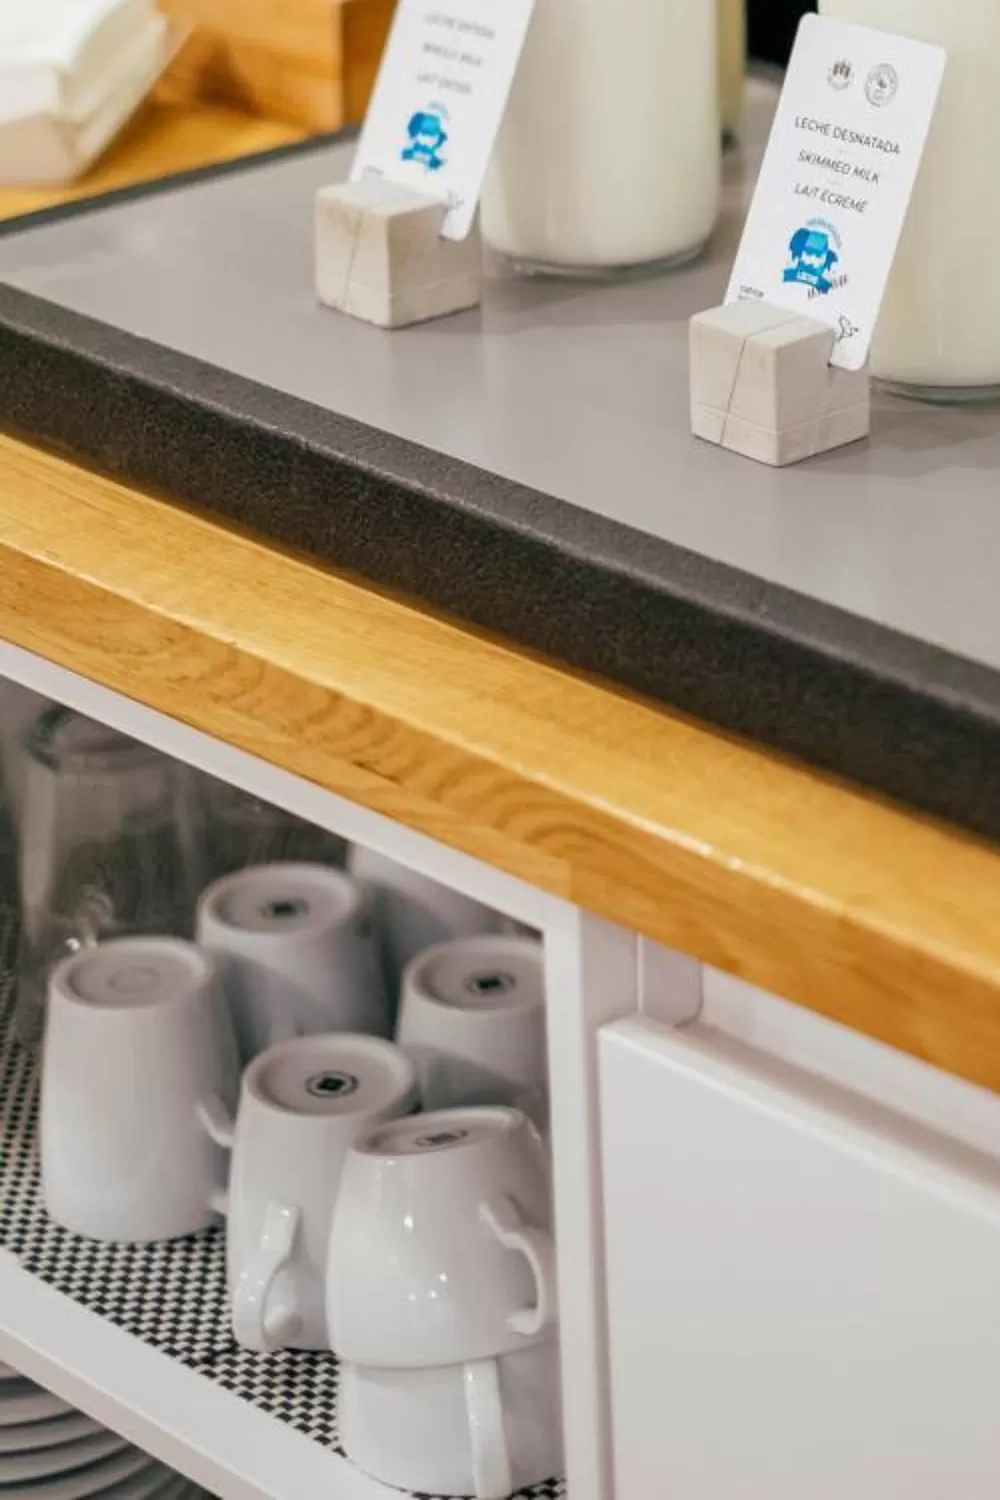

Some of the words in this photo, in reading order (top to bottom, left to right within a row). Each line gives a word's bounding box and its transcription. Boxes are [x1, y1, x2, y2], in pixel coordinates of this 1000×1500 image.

[794, 116, 831, 136] LECHE
[833, 125, 901, 155] DESNATADA
[798, 149, 850, 174] SKIMMED
[851, 165, 879, 184] MILK
[794, 182, 820, 197] LAIT
